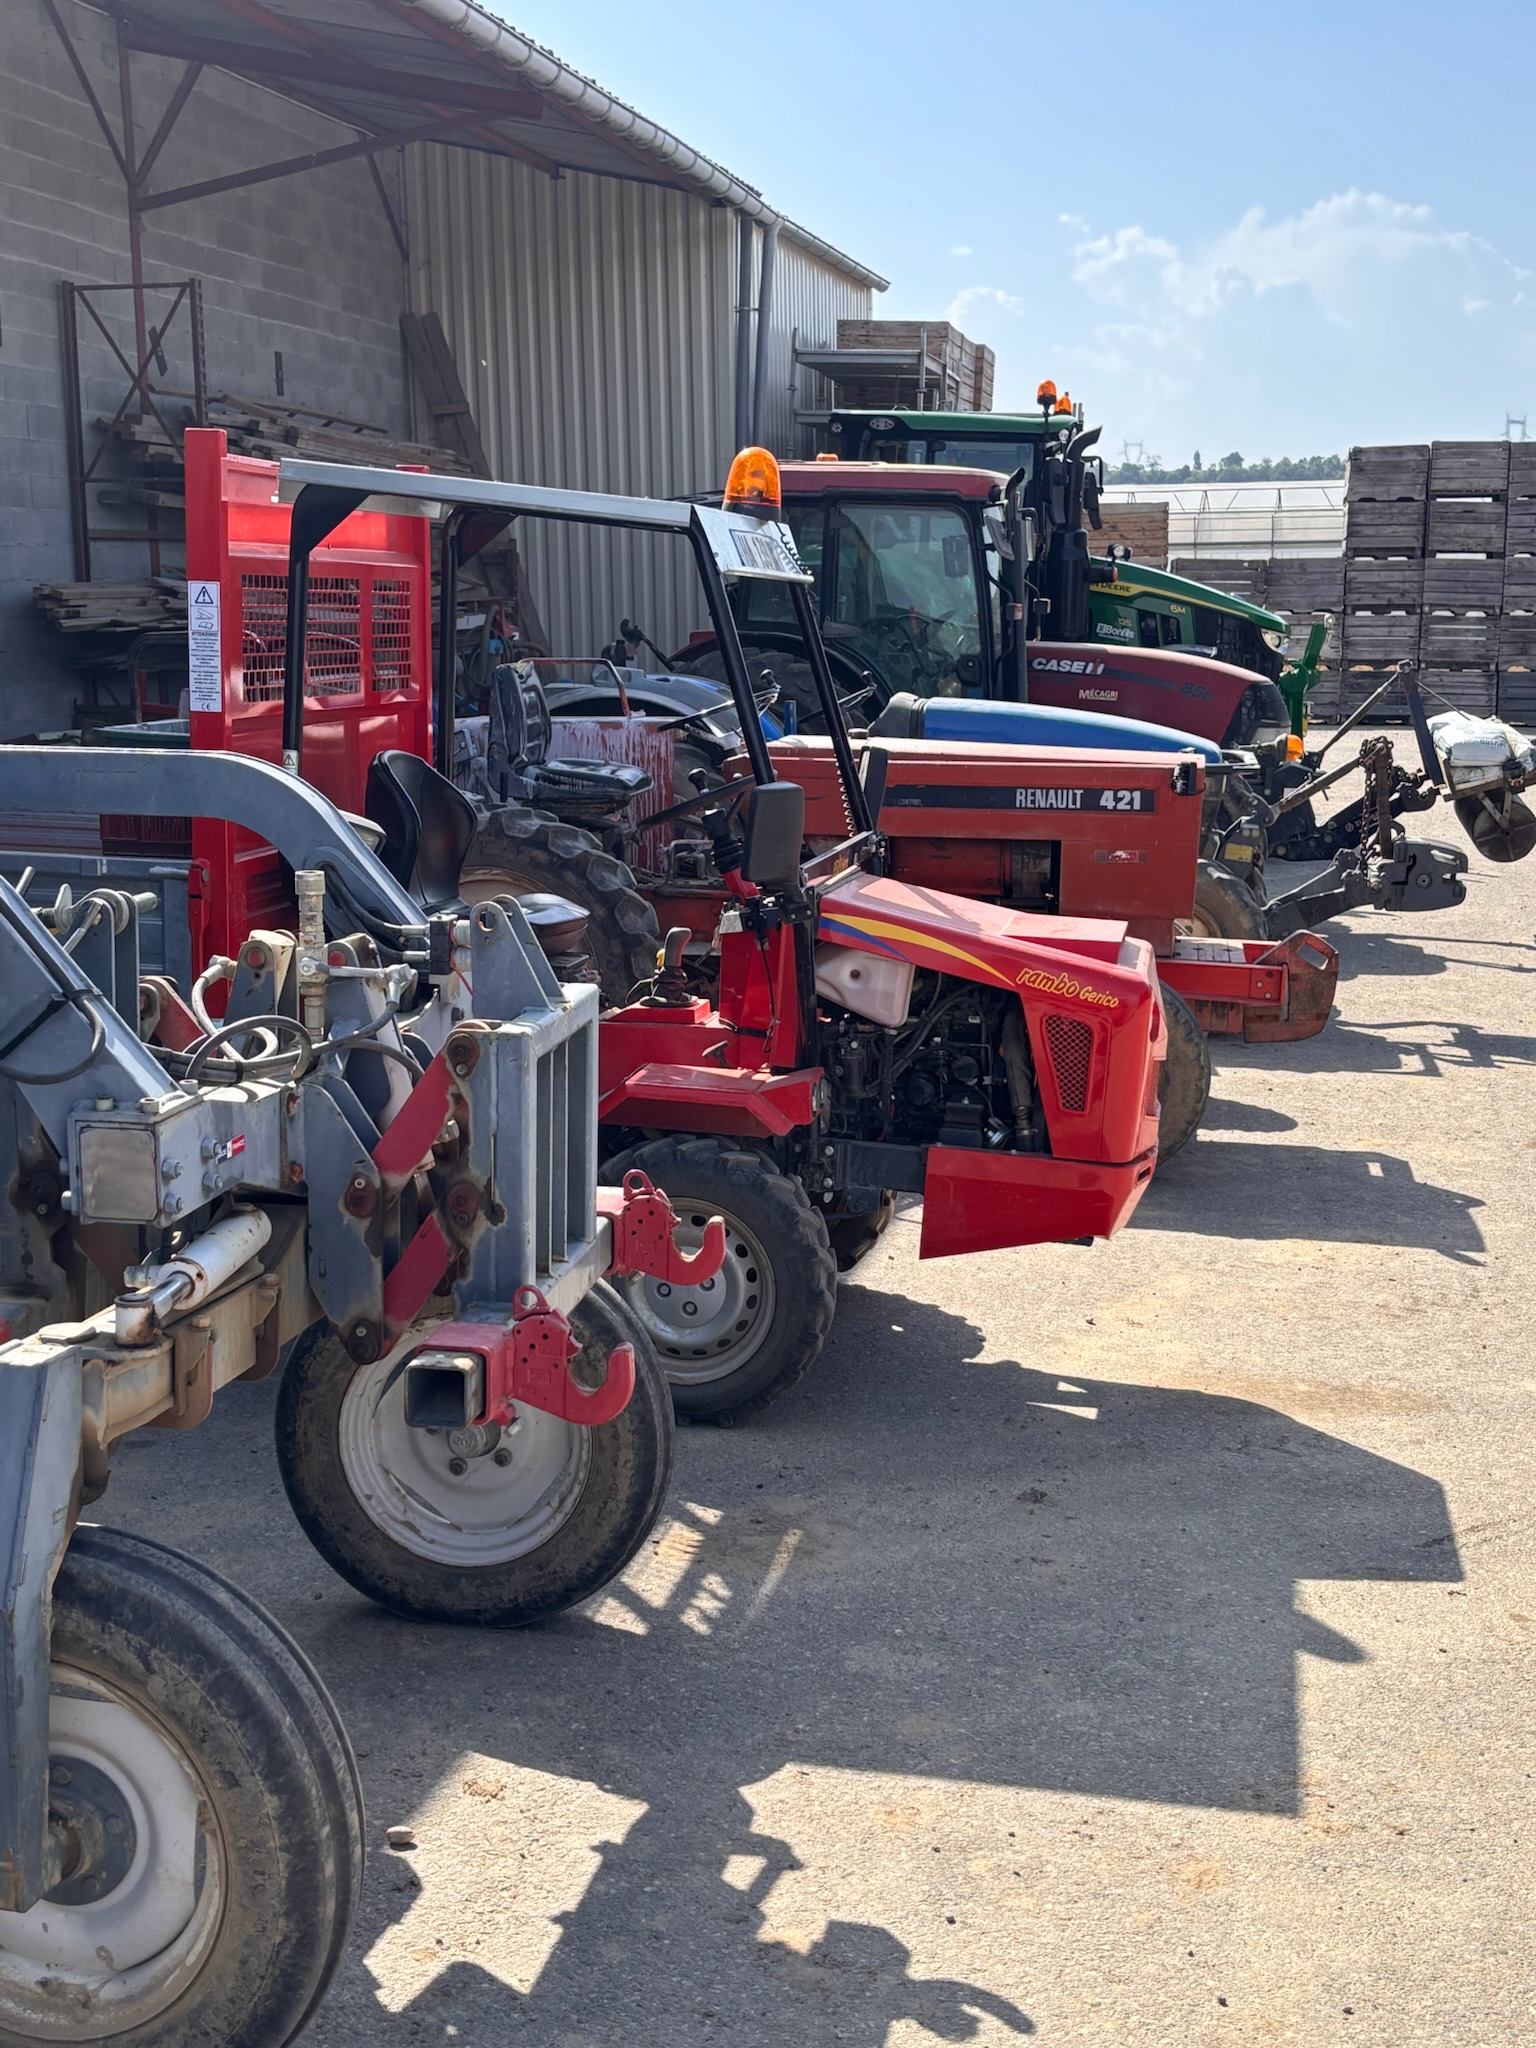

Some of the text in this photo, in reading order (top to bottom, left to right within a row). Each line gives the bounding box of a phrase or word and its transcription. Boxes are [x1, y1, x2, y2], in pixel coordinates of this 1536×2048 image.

[1101, 582, 1132, 592] DEERE
[1169, 604, 1186, 615] 6M
[1105, 624, 1135, 639] Bonfils
[1031, 657, 1086, 673] CASE
[1078, 688, 1118, 700] MÉCAGRI
[1015, 788, 1141, 811] RENAULT 421
[1016, 967, 1119, 1008] rambo Gerico
